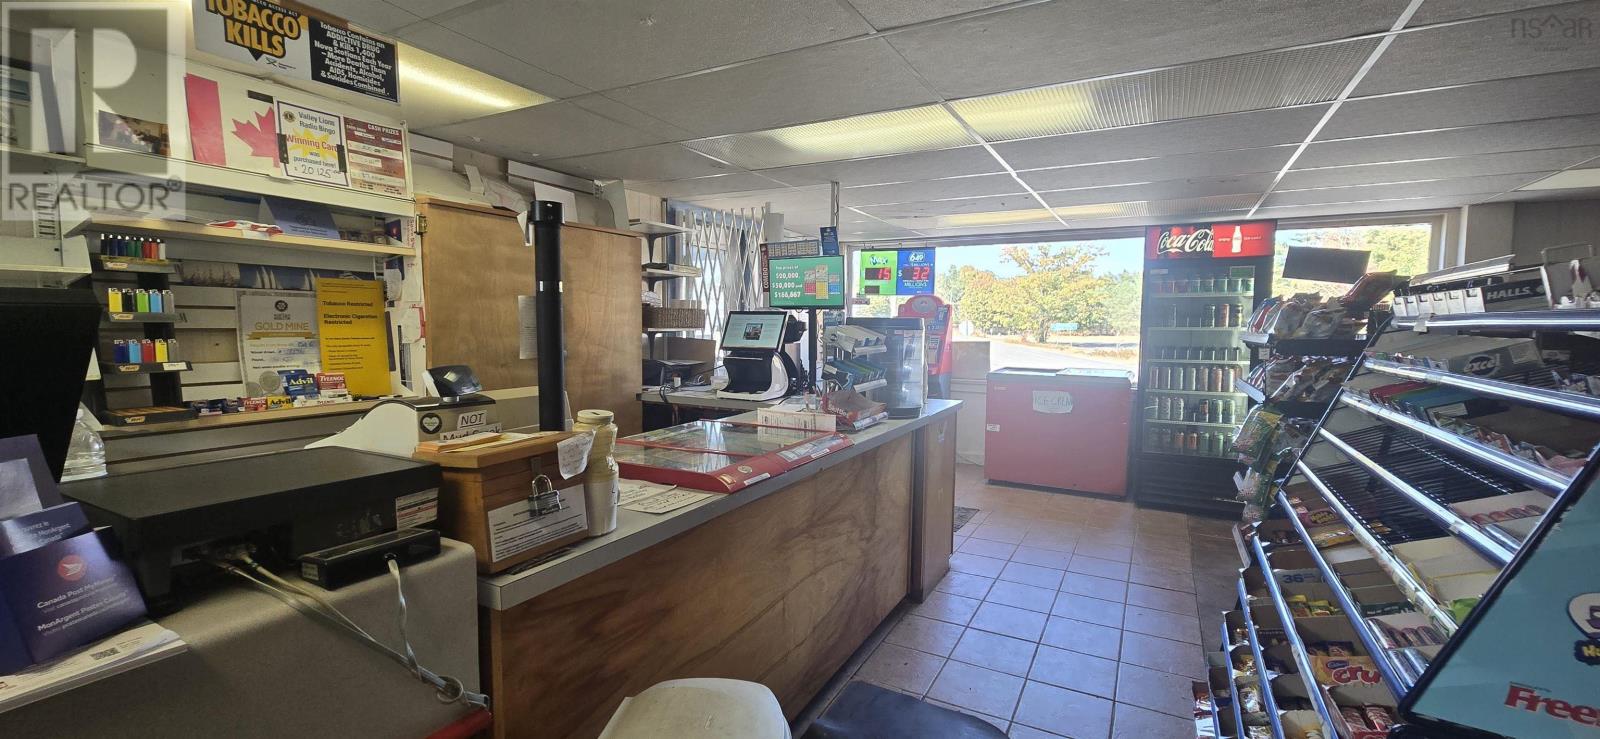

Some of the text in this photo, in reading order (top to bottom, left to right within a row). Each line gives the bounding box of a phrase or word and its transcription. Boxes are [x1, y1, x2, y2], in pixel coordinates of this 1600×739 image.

[225, 18, 284, 57] KILLS
[320, 22, 346, 36] Tobacco
[347, 32, 376, 47] Contains
[326, 30, 380, 54] ADDICTIVE DRUG
[314, 40, 392, 70] Nova Scotians Each Year
[340, 42, 354, 52] Kills
[355, 46, 376, 58] 1,400
[325, 58, 384, 82] Accidents, Alcohol,
[346, 57, 370, 68] Deaths
[370, 65, 386, 75] Than
[327, 72, 353, 85] Suicides
[330, 66, 381, 86] AIDS, Homicides
[299, 112, 335, 126] Valley Lions
[300, 120, 318, 130] Radio
[319, 125, 336, 135] Bingo
[368, 124, 382, 132] CASH
[286, 134, 320, 149] Winning
[294, 157, 321, 165] purchased
[1157, 228, 1214, 254] Coca-Cola
[878, 268, 891, 282] 15
[912, 267, 930, 280] 32
[1487, 286, 1533, 300] HALLS
[255, 322, 309, 330] GOLD MINE
[1464, 354, 1500, 375] excel
[289, 377, 314, 386] Advil
[460, 413, 484, 425] NOT
[37, 594, 67, 608] Canada
[67, 588, 84, 597] Post
[37, 610, 80, 631] MonArgent
[1504, 685, 1600, 728] Free
